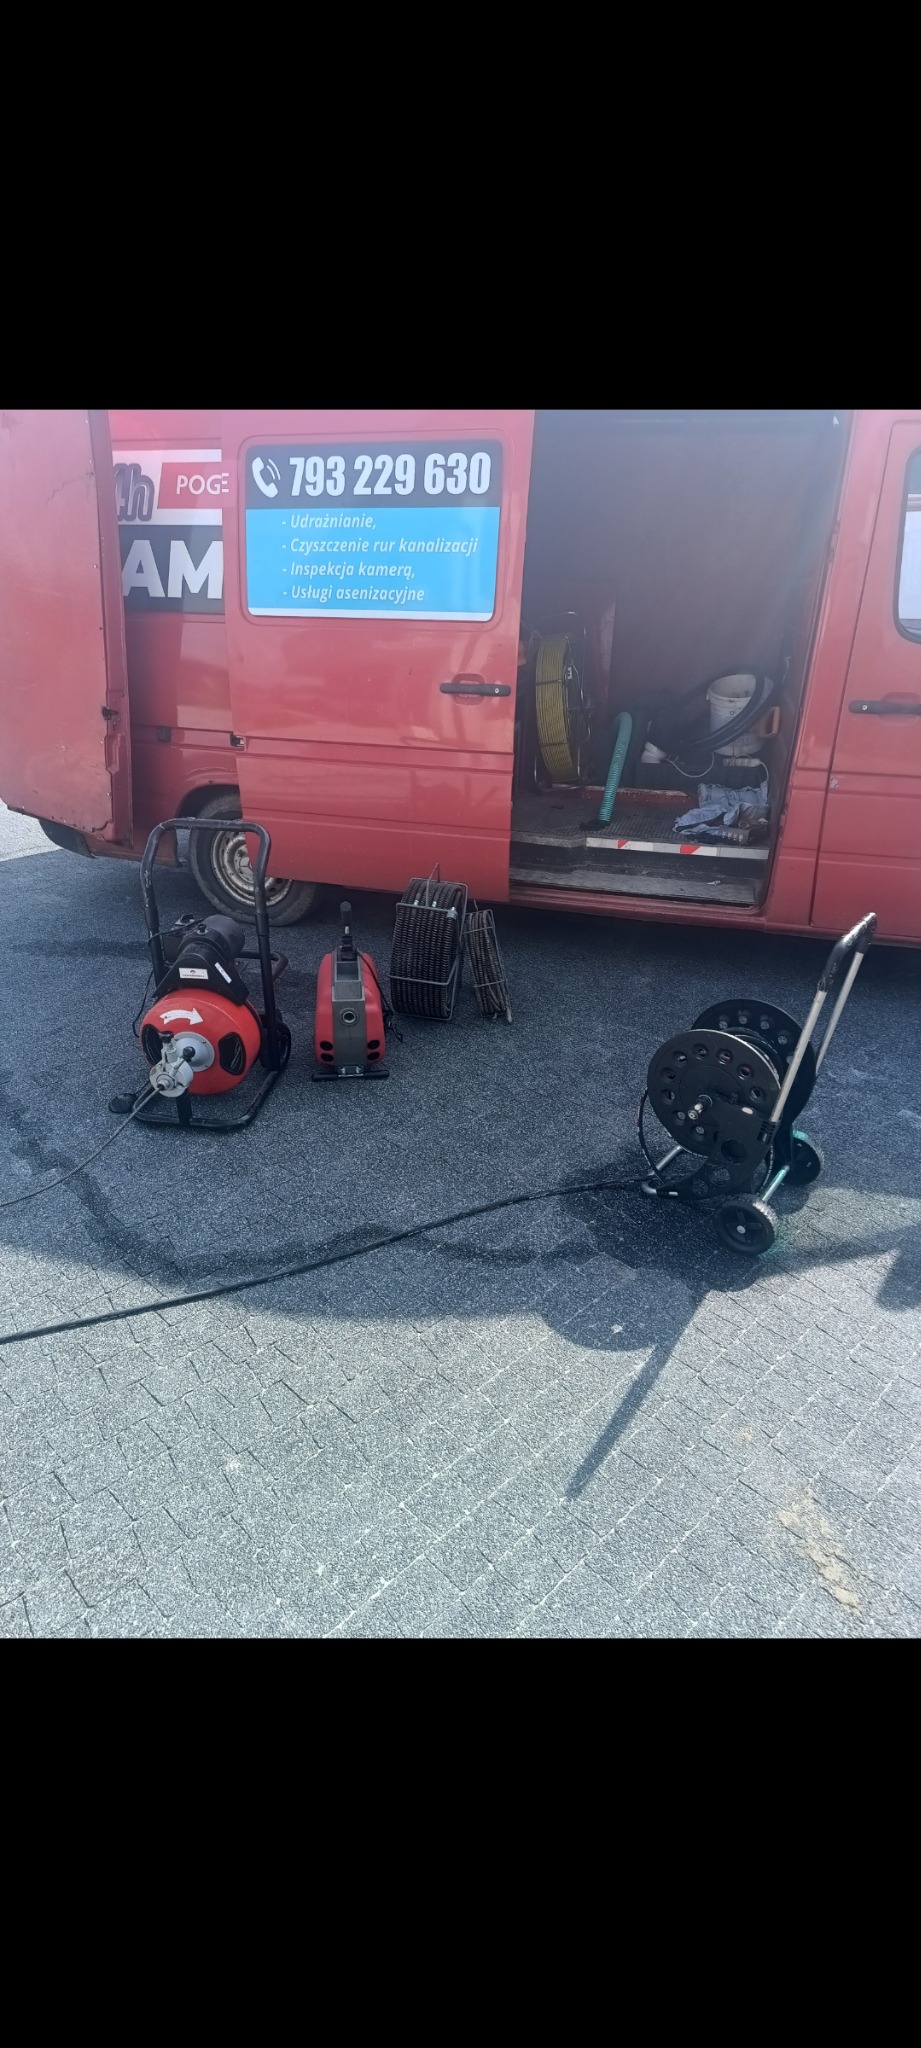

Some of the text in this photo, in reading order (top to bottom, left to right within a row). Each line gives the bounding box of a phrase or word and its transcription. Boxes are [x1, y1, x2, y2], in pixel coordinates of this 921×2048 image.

[289, 451, 492, 497] 793 229 630
[290, 513, 377, 531] Udrażnianie,
[290, 537, 370, 556] Czyszczenie
[373, 540, 396, 553] rur
[398, 537, 479, 557] kanalizacji
[122, 539, 224, 599] AM
[290, 561, 355, 580] Inspekcja
[358, 561, 415, 581] kamerą,
[291, 584, 333, 603] Usługi
[336, 585, 425, 605] asenizacyjne
